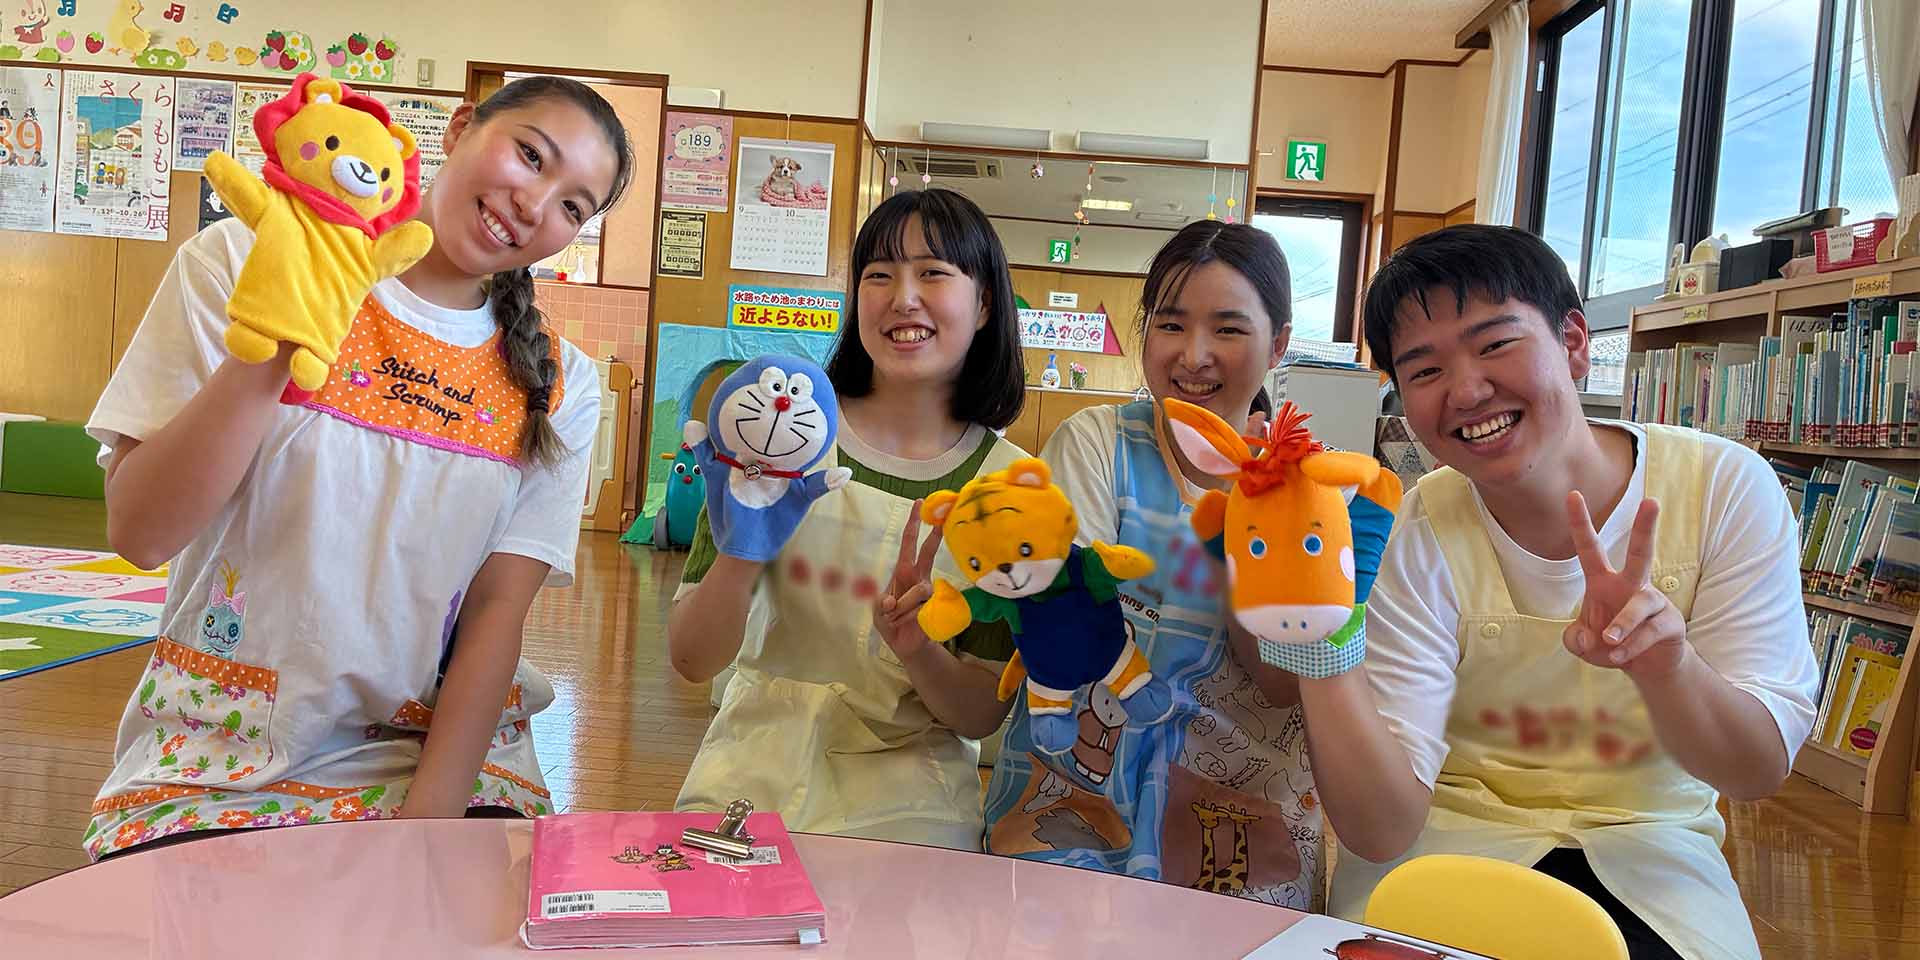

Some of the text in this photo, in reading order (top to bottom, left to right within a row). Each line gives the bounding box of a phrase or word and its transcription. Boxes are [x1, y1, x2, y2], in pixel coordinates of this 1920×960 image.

[689, 134, 711, 147] 189
[786, 209, 796, 217] 10
[734, 291, 840, 309] 水路やため池のまわりには
[739, 306, 832, 328] 近よらない!
[373, 356, 475, 406] Stitch and
[383, 382, 463, 427] Scrump
